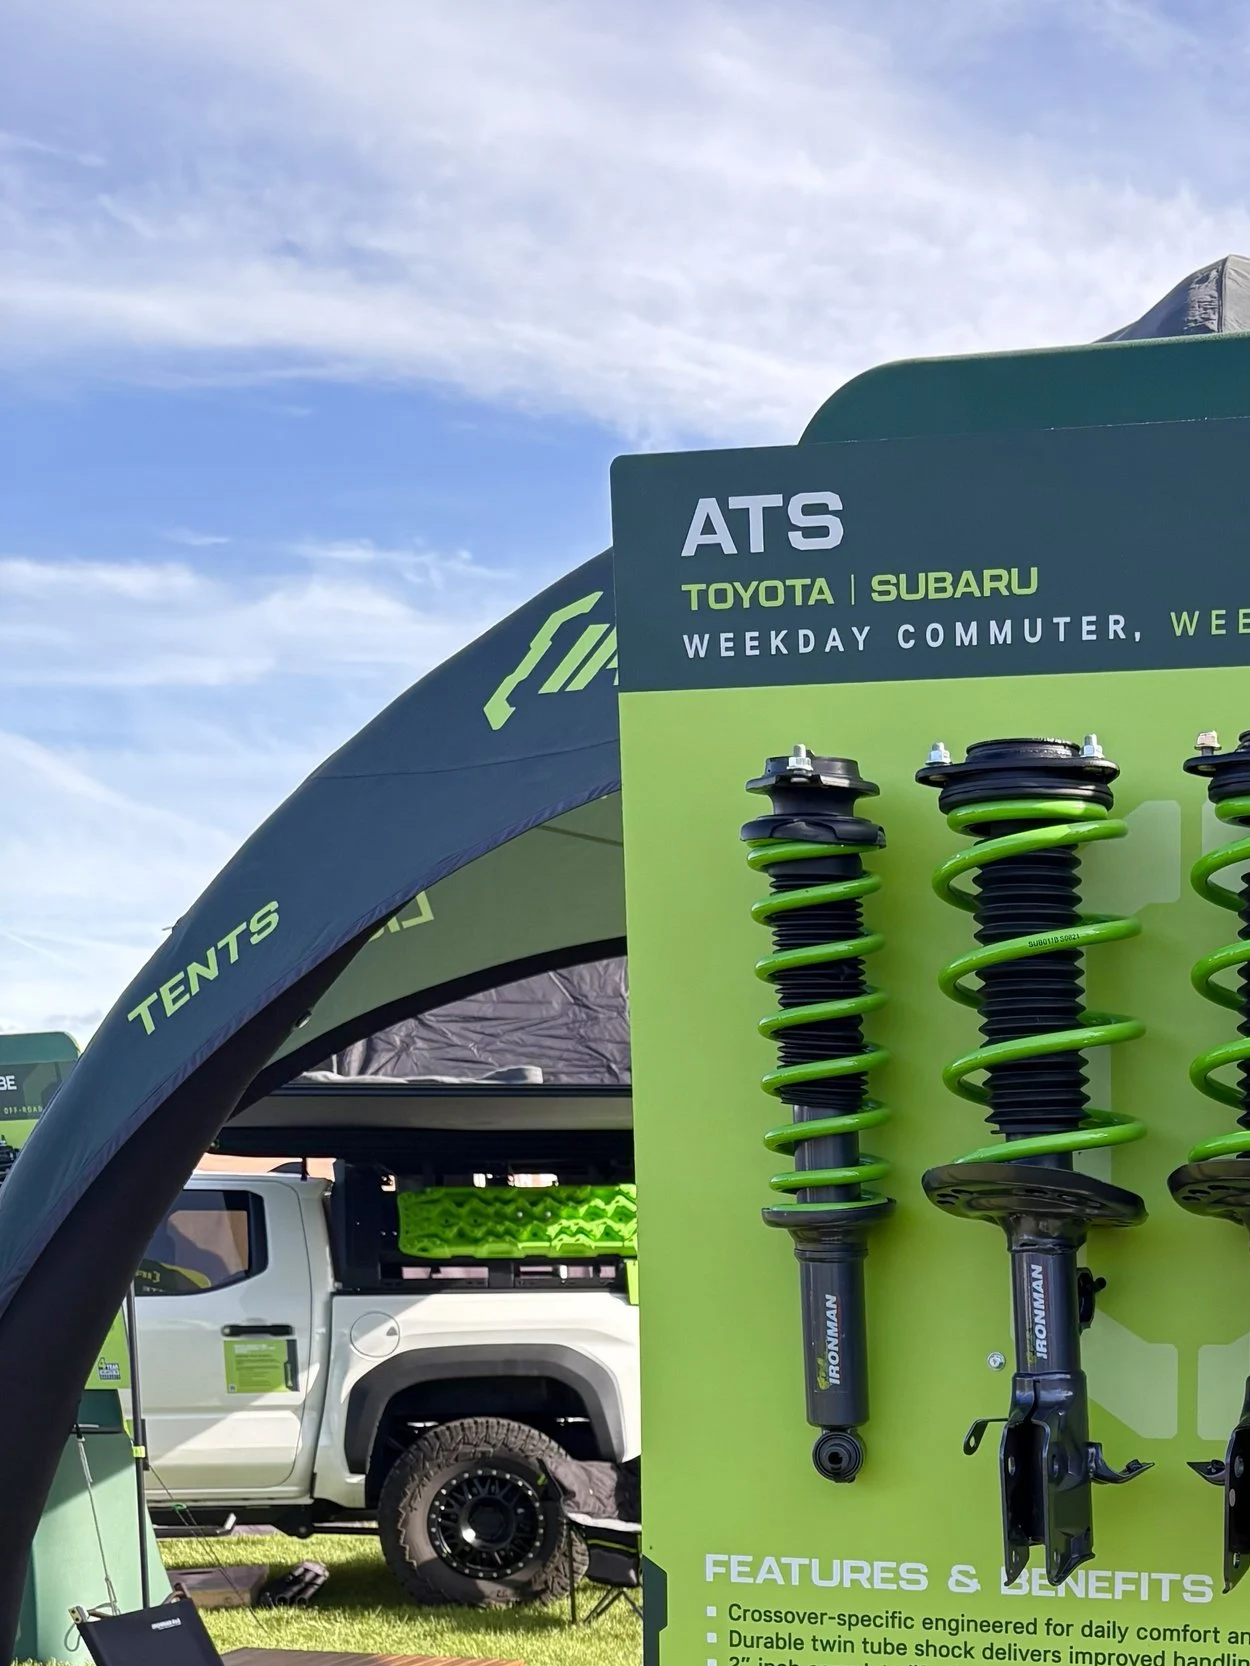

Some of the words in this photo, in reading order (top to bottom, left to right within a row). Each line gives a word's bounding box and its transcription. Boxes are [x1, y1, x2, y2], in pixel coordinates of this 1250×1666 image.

[681, 491, 843, 556] ATS
[681, 576, 835, 611] TOYOTA
[870, 566, 1039, 602] SUBARU
[682, 625, 871, 658] WEEKDAY
[898, 613, 1142, 649] COMMUTER,
[127, 901, 281, 1036] TENTS
[1031, 1264, 1048, 1360] IRONMAN
[825, 1294, 841, 1385] IRONMAN
[705, 1553, 929, 1592] FEATURES
[947, 1564, 981, 1593] &
[1000, 1567, 1214, 1603] BENEFITS
[728, 1603, 915, 1632] Crossover-specific
[921, 1613, 1038, 1637] engineered
[1044, 1617, 1075, 1637] for
[1080, 1619, 1130, 1644] daily
[1136, 1623, 1221, 1644] comfort
[729, 1629, 805, 1651] Durable
[810, 1634, 855, 1654] twin
[861, 1637, 908, 1656] tube
[914, 1638, 975, 1660] shock
[981, 1642, 1062, 1664] delivers
